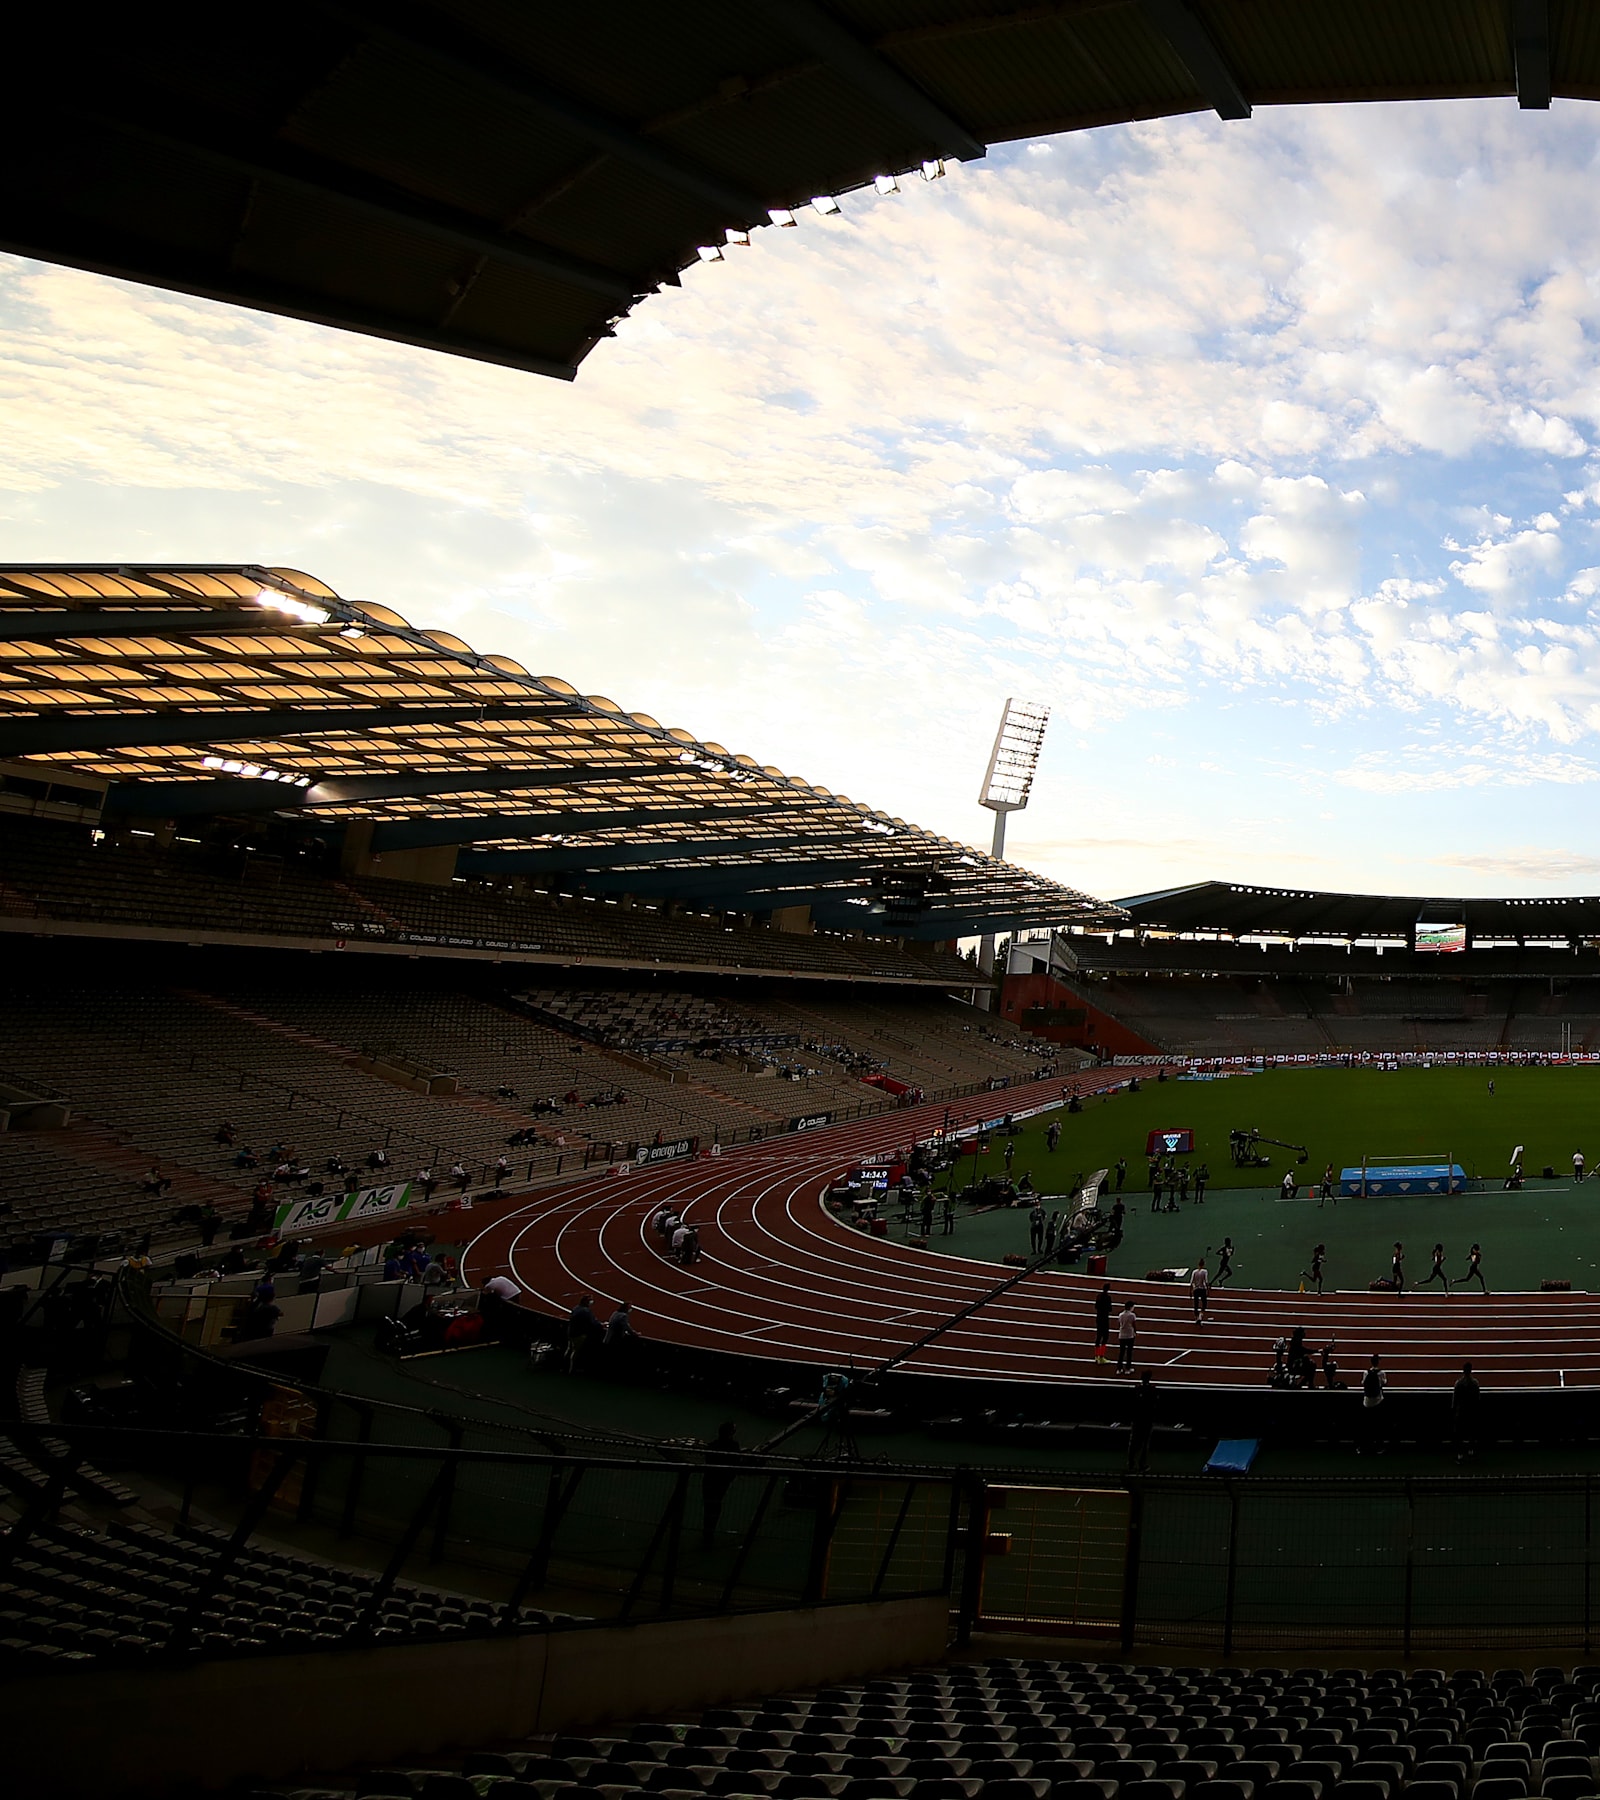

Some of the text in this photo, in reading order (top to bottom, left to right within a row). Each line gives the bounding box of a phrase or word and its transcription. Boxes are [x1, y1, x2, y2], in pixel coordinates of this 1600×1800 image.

[651, 1140, 689, 1159] energy lab
[292, 1186, 395, 1223] AG AG
[462, 1196, 469, 1205] 3
